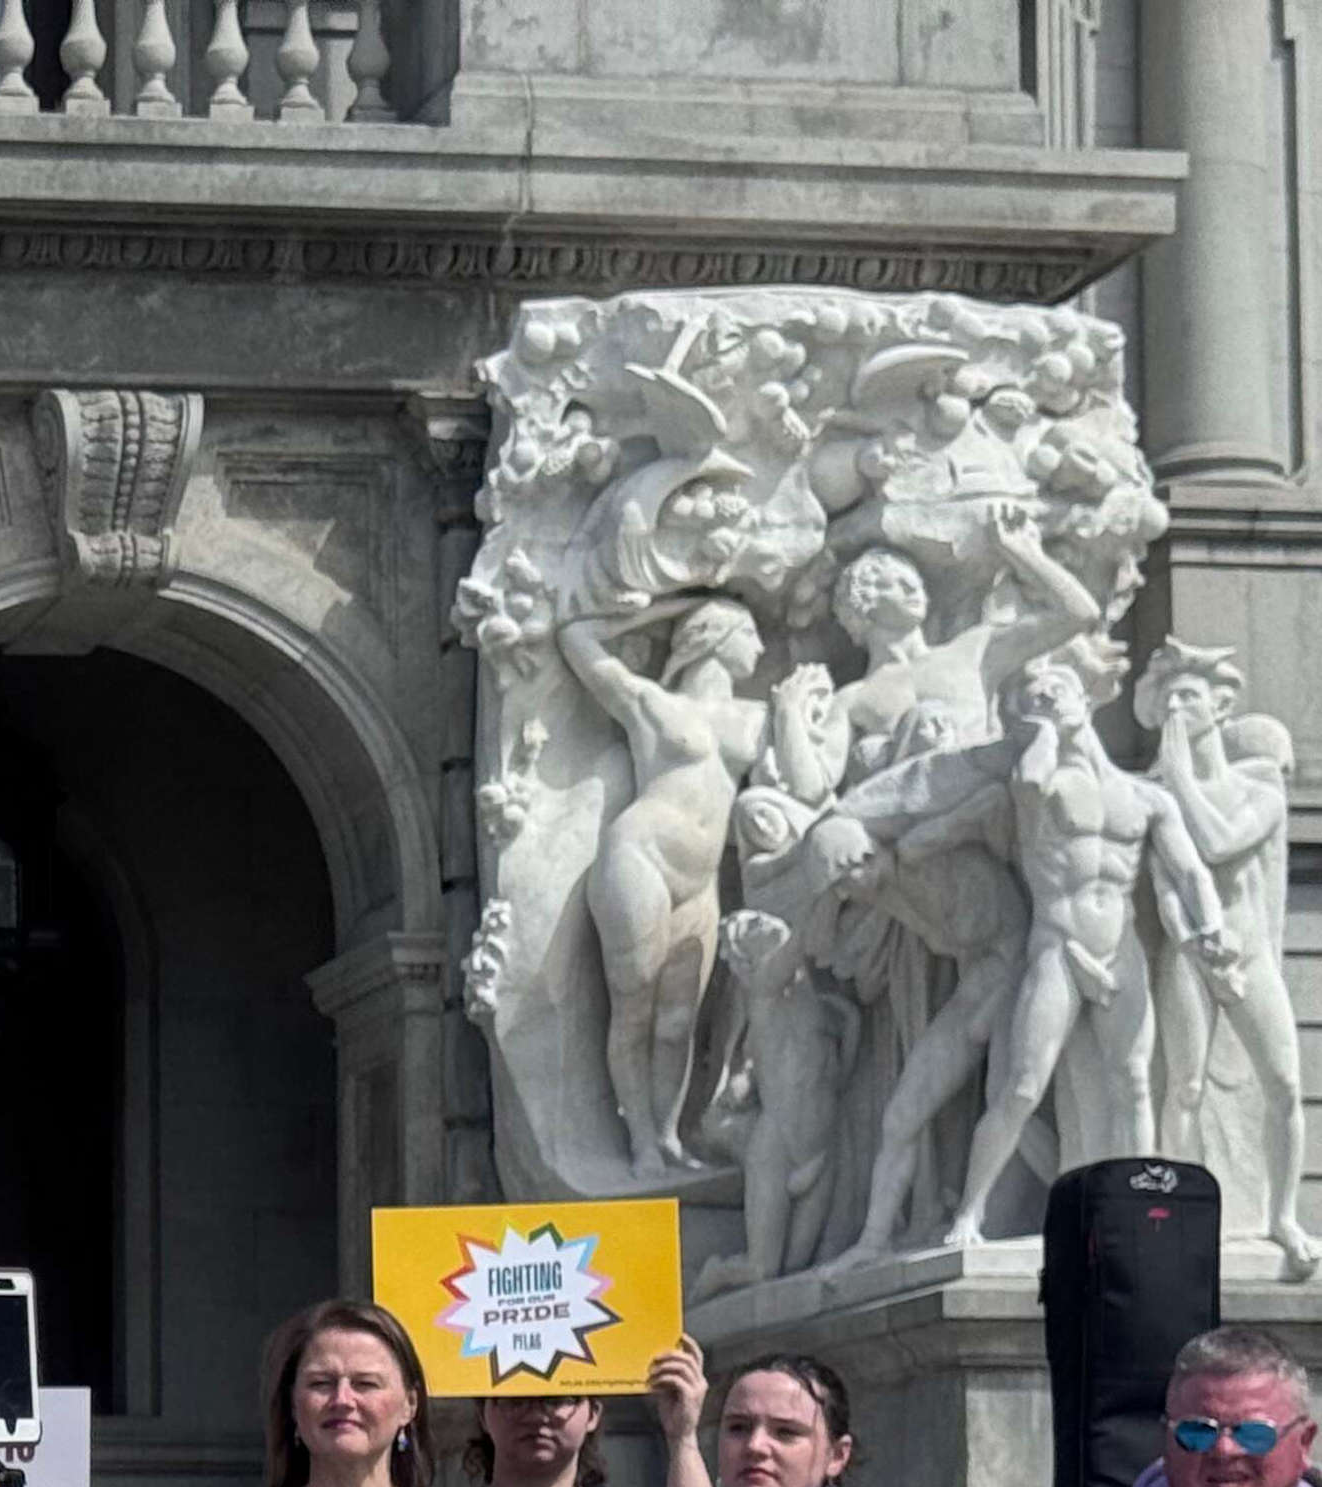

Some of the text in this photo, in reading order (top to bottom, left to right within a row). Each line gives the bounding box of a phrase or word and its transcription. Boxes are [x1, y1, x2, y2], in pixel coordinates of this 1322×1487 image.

[488, 1261, 563, 1298] FIGHTING
[483, 1302, 571, 1327] PRIDE
[512, 1332, 542, 1350] PFLAG
